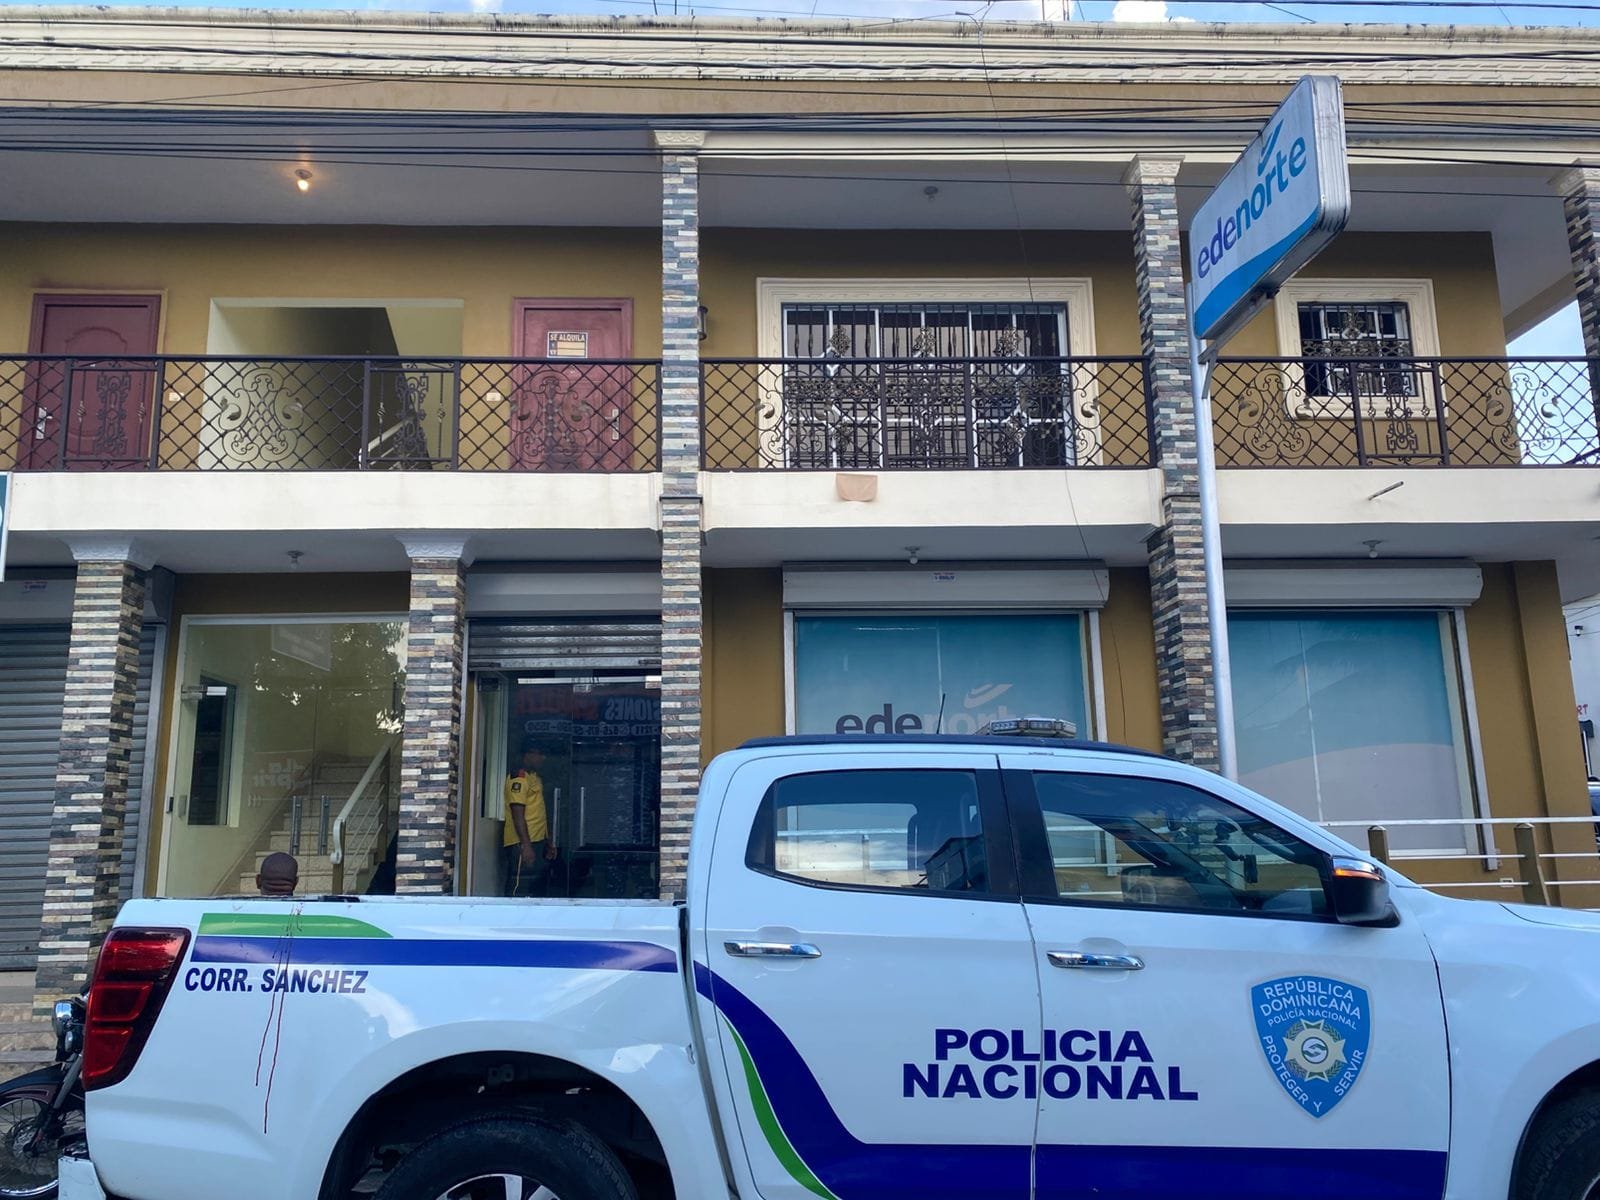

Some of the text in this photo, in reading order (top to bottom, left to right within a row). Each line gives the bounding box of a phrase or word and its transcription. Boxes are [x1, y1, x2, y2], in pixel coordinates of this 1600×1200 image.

[1197, 136, 1307, 279] edenorte
[559, 333, 585, 341] ALQUILA
[184, 967, 369, 994] CORR. SANCHEZ
[1263, 977, 1354, 1002] REPÚBLICA
[1260, 993, 1361, 1021] DOMINICANA
[1267, 1008, 1357, 1030] POLICÍA NACIONAL
[935, 1029, 1154, 1062] POLICIA
[903, 1063, 1199, 1101] NACIONAL
[1263, 1035, 1364, 1113] PROTEGER Y SERVIR
